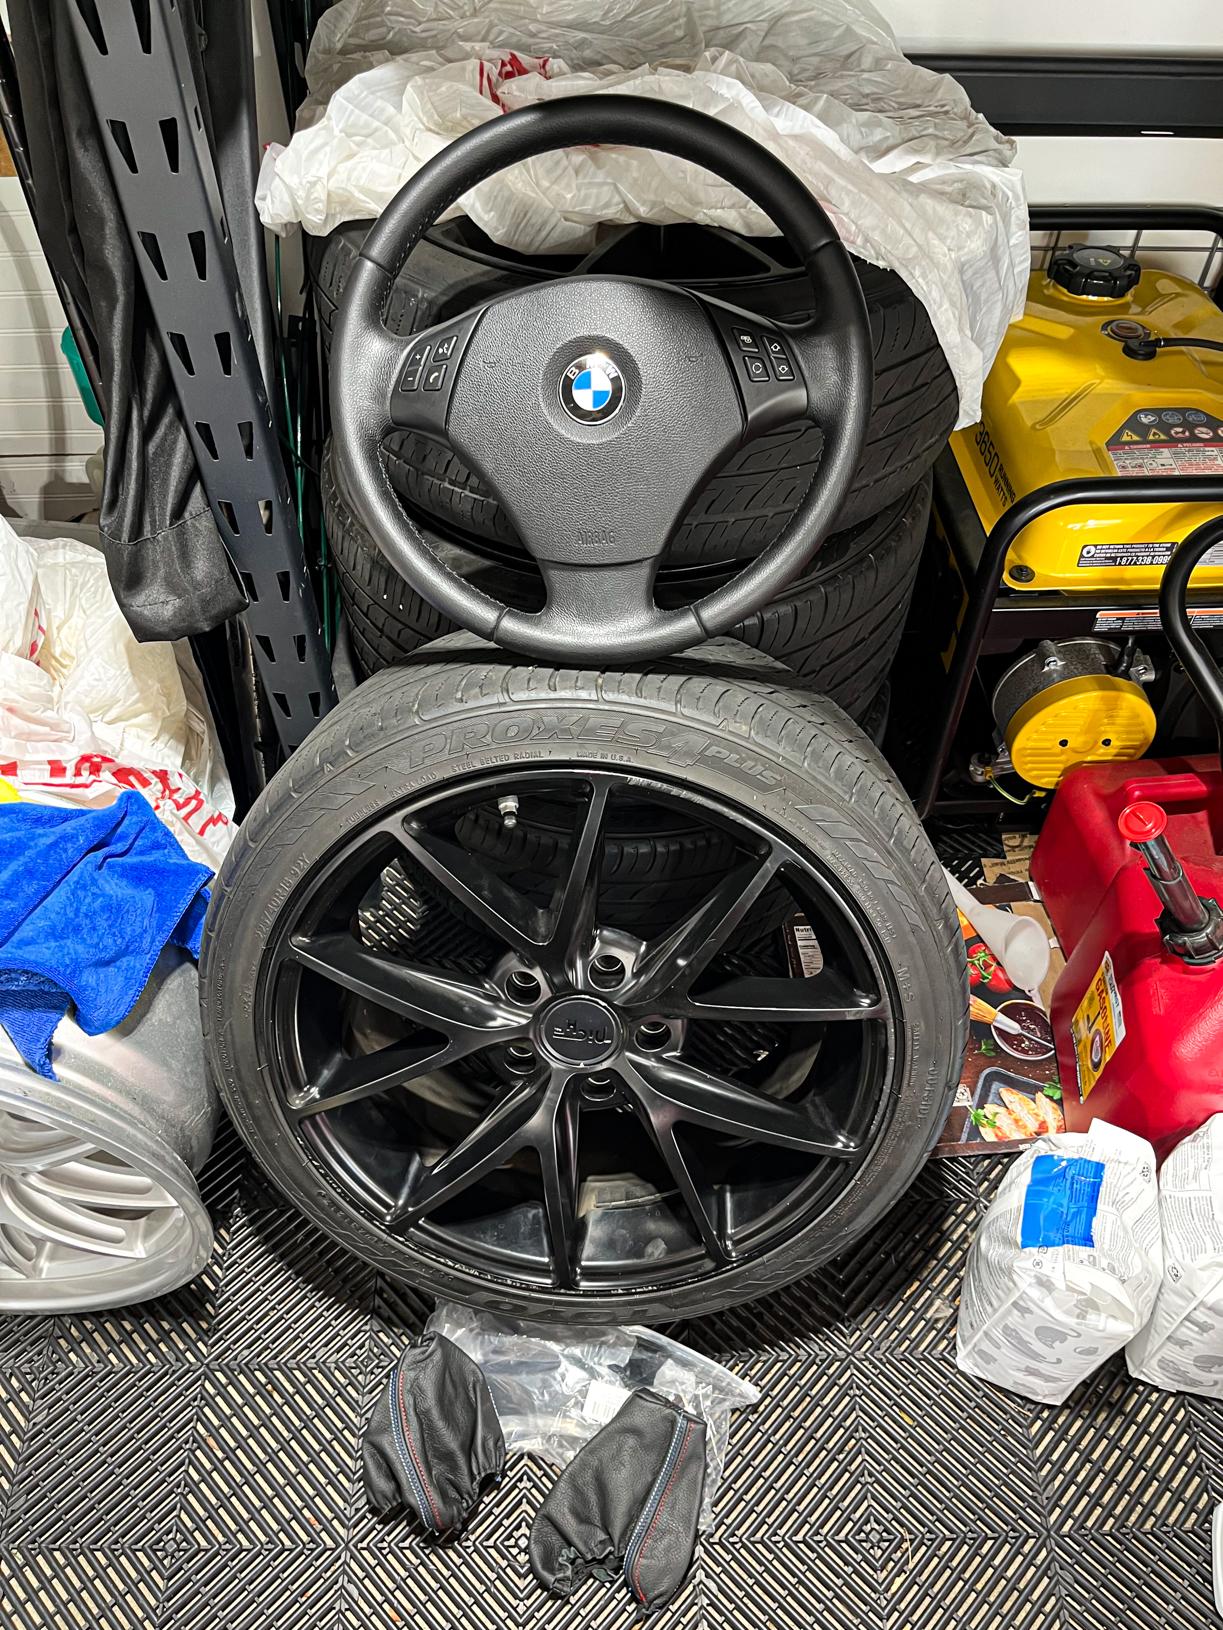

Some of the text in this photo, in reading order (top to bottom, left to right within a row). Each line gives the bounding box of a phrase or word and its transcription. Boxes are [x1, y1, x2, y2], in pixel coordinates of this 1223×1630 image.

[975, 421, 1000, 479] 3650
[994, 475, 1008, 507] WATTS
[999, 463, 1016, 504] RUNNING
[577, 530, 615, 546] AIRBAG
[403, 714, 784, 786] PROXES 4 PLUS
[451, 751, 544, 773] STEEL BELTED RADIAL
[576, 751, 634, 763] MADE IN U.S.A.
[1095, 978, 1112, 1052] GASOLINE
